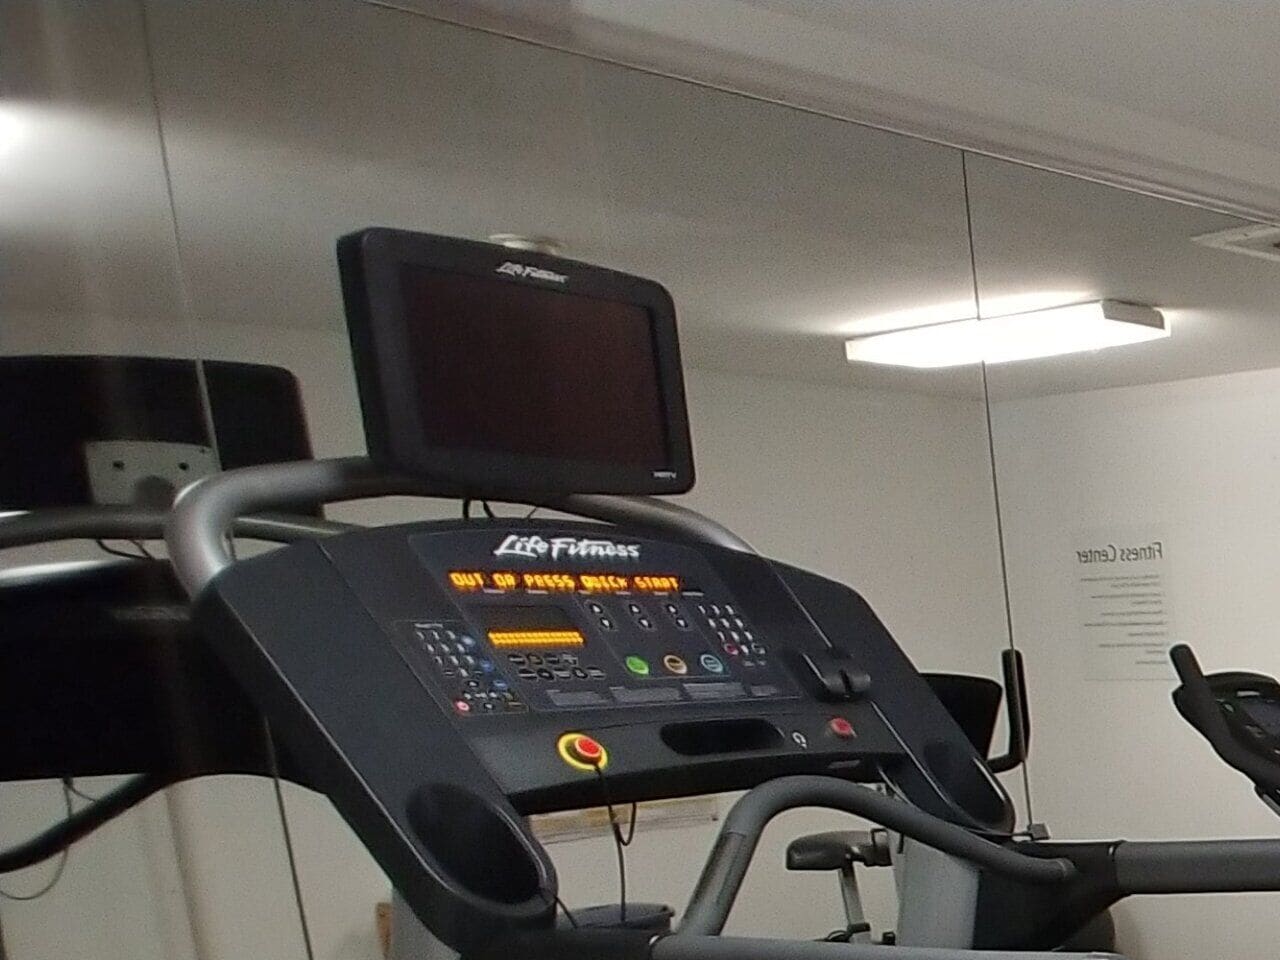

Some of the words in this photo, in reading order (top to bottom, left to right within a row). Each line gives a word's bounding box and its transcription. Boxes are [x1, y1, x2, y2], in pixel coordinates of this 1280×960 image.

[493, 534, 548, 558] Life
[549, 537, 641, 561] Fitness
[449, 571, 484, 588] OUT
